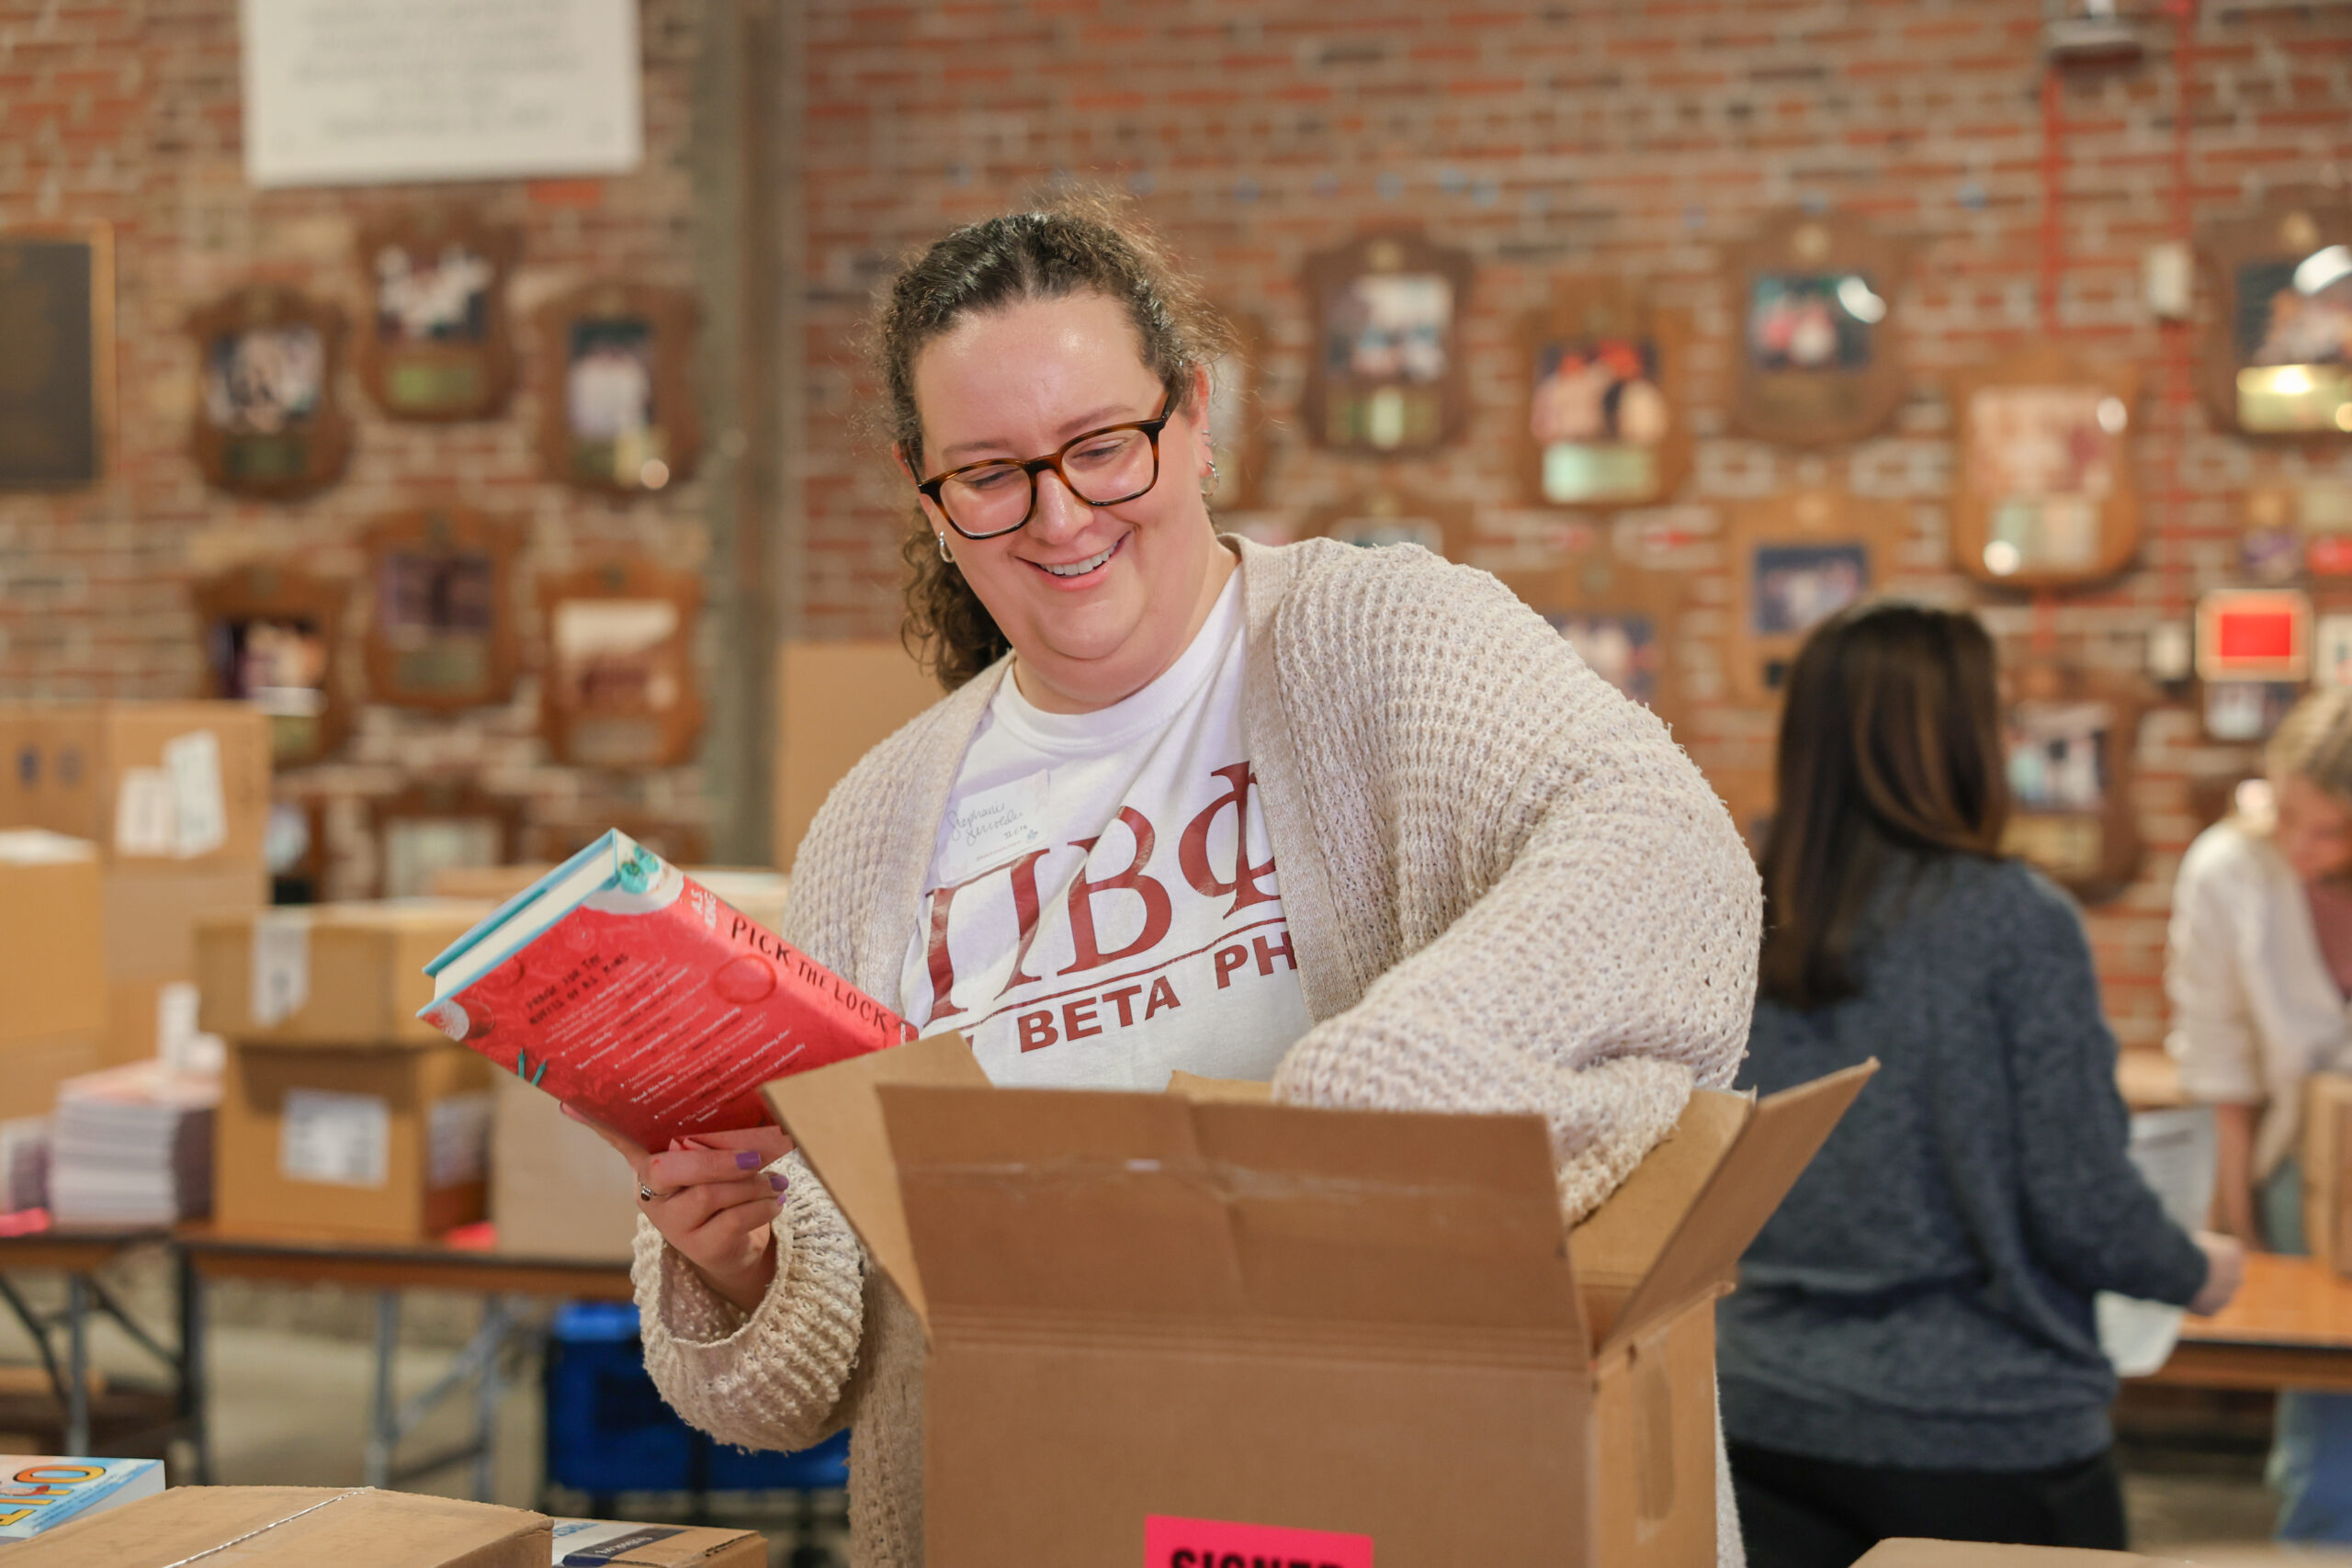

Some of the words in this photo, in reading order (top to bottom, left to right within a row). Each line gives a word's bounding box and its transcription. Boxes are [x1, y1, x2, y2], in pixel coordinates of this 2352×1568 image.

[731, 916, 791, 967] PICK
[797, 959, 827, 988] THE
[833, 980, 888, 1032] LOCK
[1017, 976, 1181, 1053] BETA
[1214, 931, 1296, 989] PH
[1170, 1547, 1345, 1568] SIG
